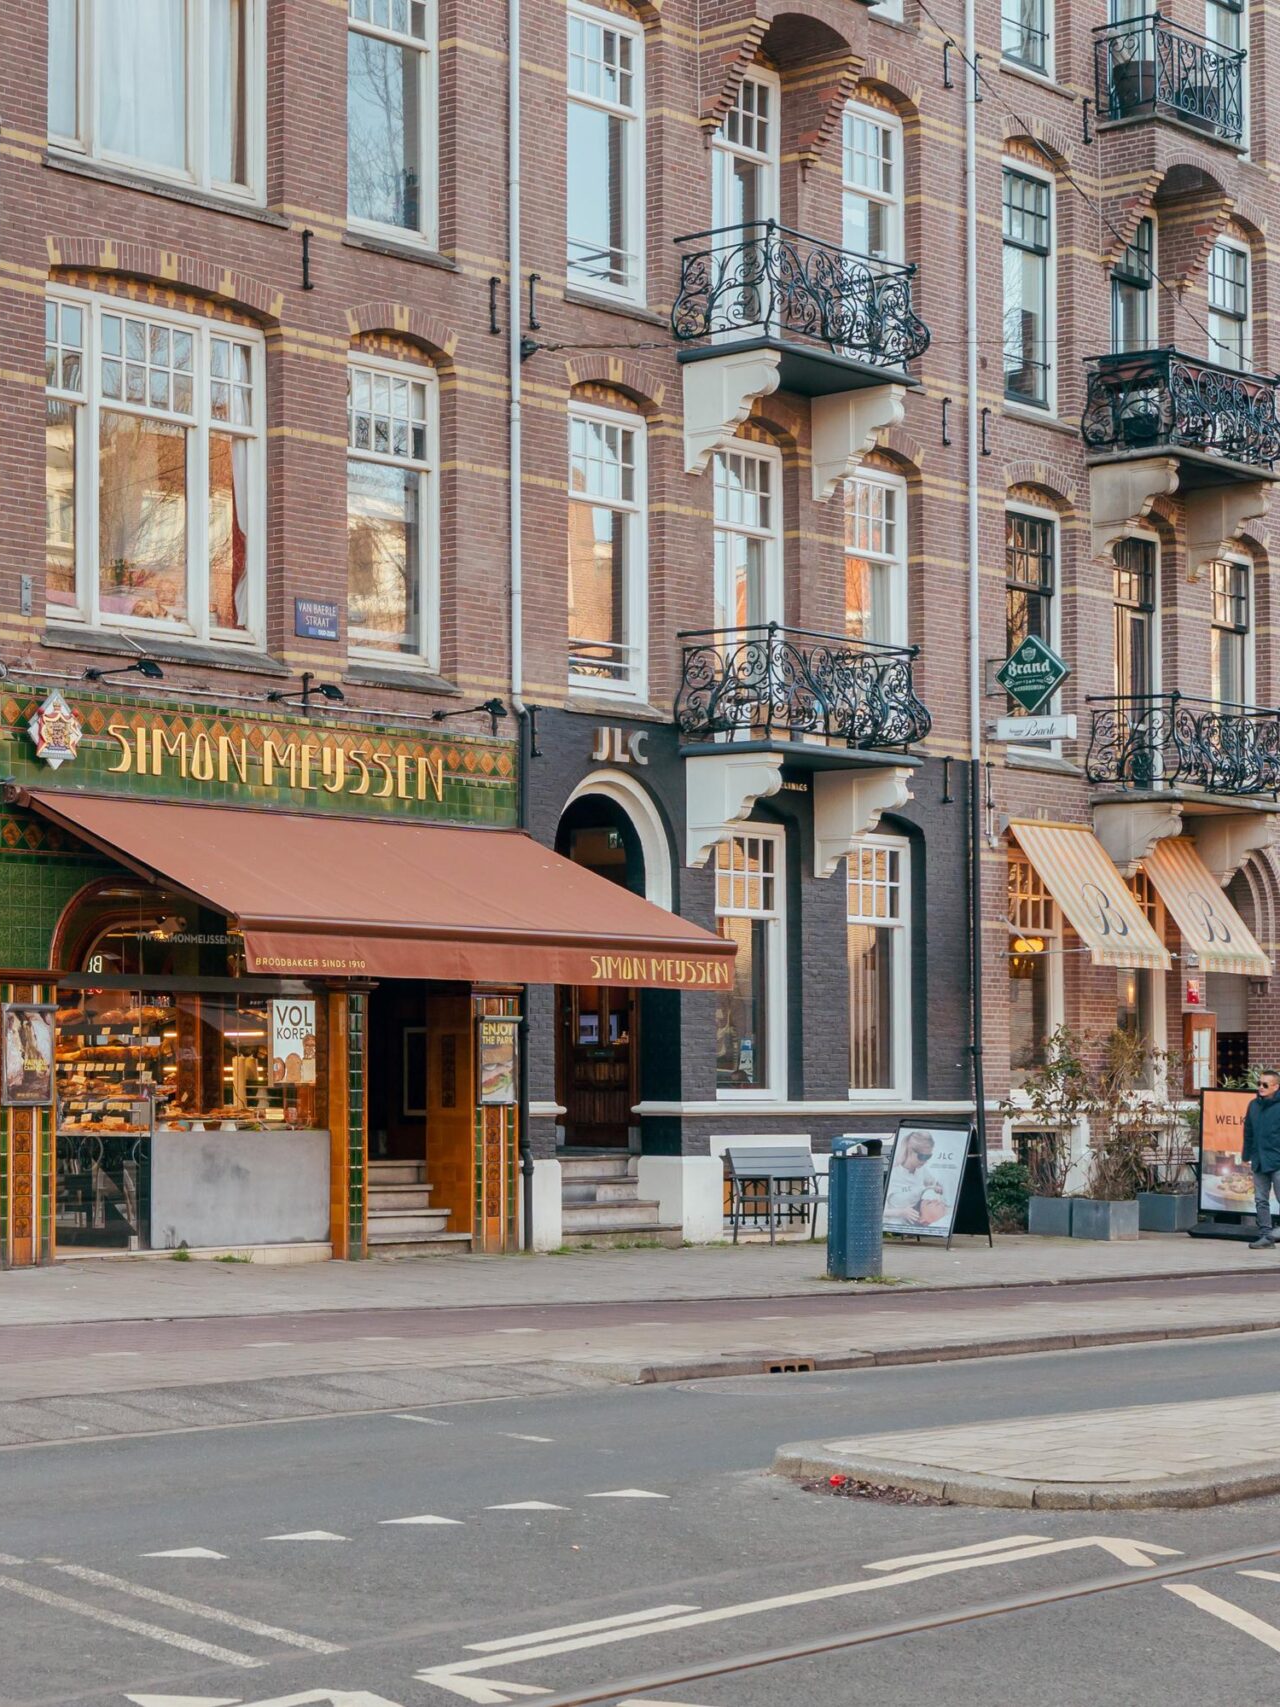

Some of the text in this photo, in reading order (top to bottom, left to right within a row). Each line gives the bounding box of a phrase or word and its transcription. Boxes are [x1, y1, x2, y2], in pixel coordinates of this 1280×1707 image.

[298, 602, 337, 617] VAN BAERLE
[305, 615, 330, 628] STRAAT
[1008, 659, 1051, 677] Brand
[593, 726, 648, 765] JLC
[108, 725, 247, 783] SIMON
[255, 957, 366, 968] BROODBAKKER SINDS 1910
[590, 955, 646, 980] SIMON
[276, 1006, 313, 1027] VOL
[276, 1027, 313, 1040] KOREN
[482, 1023, 513, 1036] ENJOY
[482, 1036, 514, 1045] THE PARK
[1215, 1114, 1244, 1126] WELK
[937, 1152, 954, 1160] JLC
